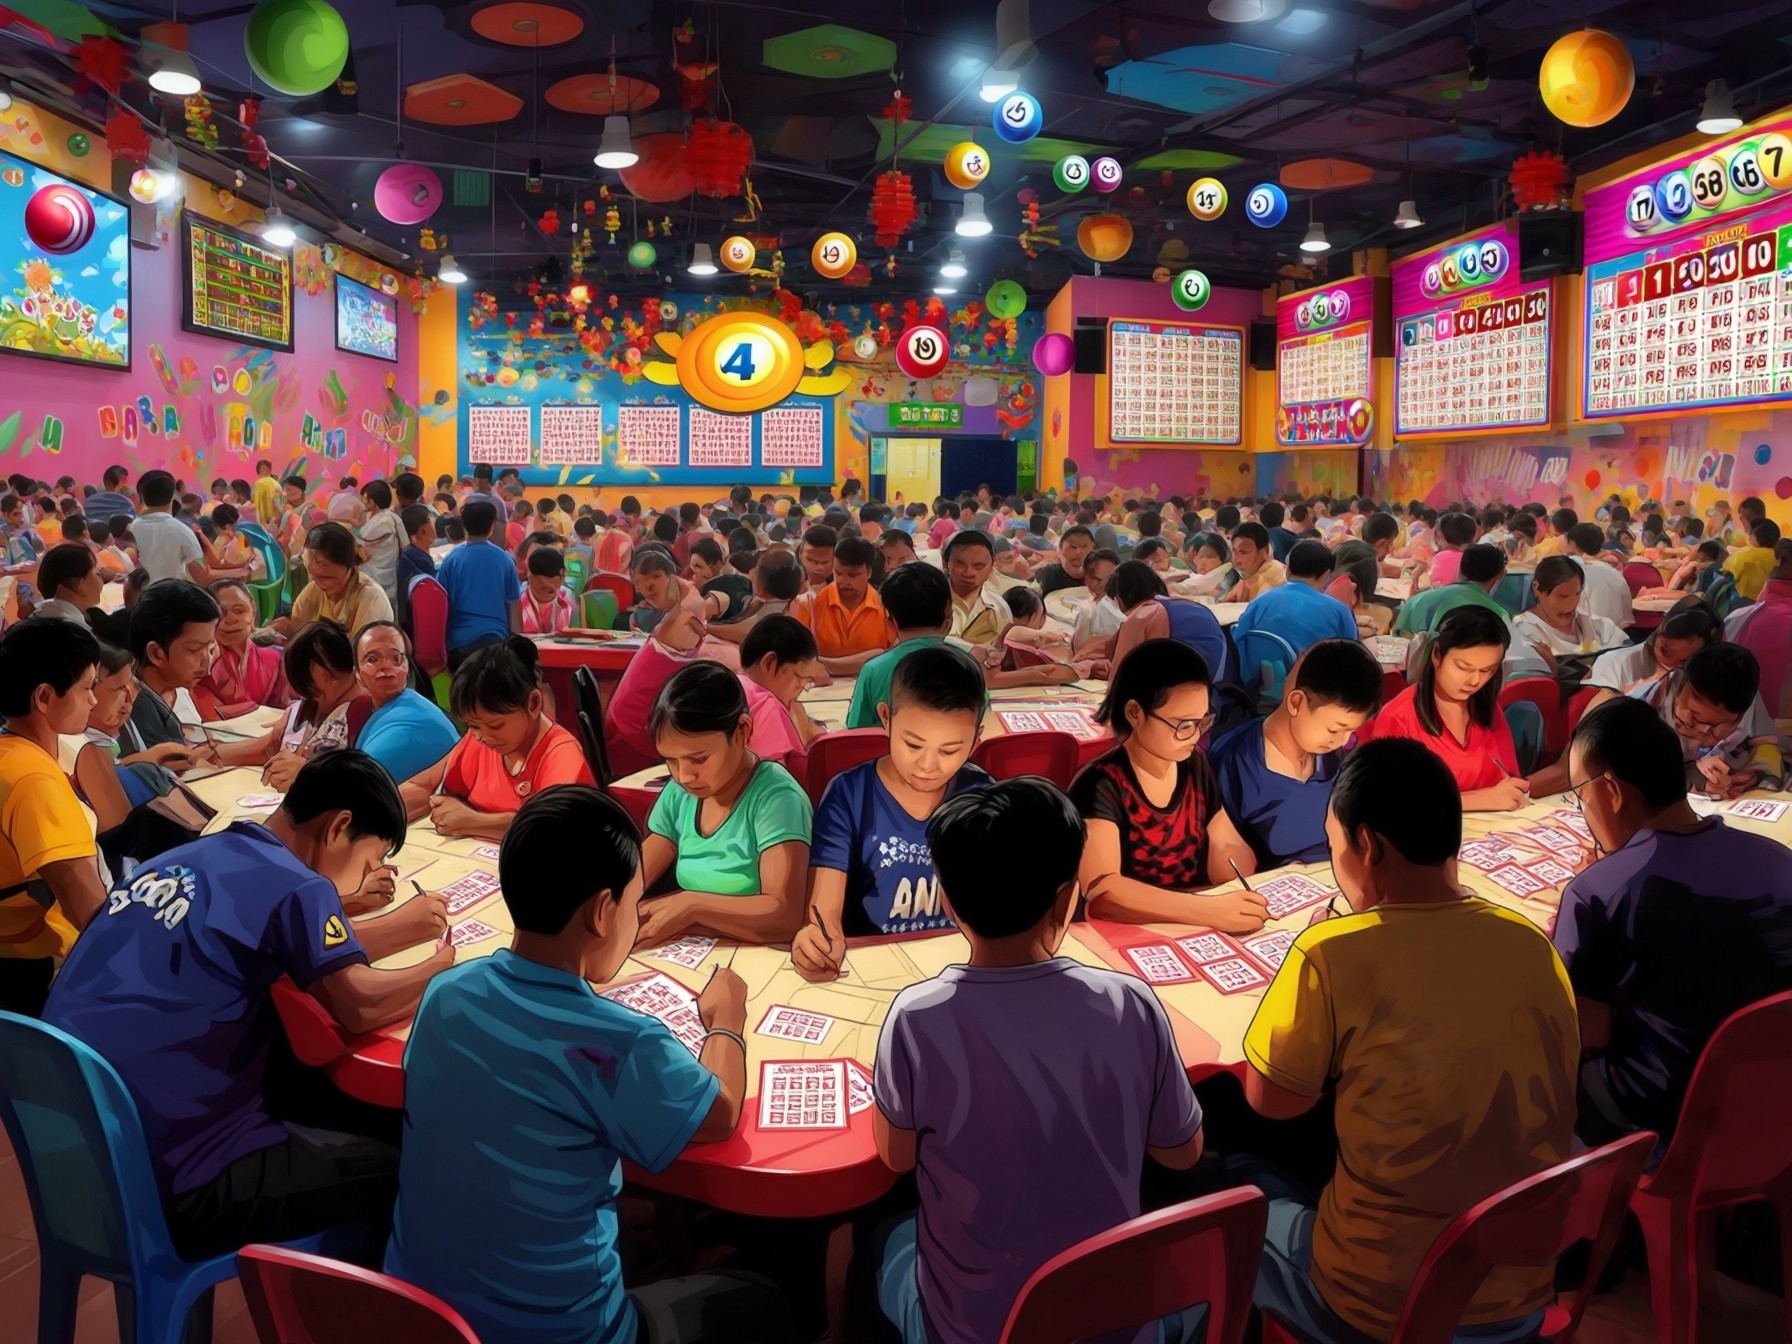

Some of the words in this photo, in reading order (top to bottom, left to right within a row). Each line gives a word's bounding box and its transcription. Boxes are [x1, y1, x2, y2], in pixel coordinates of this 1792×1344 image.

[1764, 146, 1783, 178] 7
[1747, 240, 1772, 270] 10
[720, 342, 756, 381] 4
